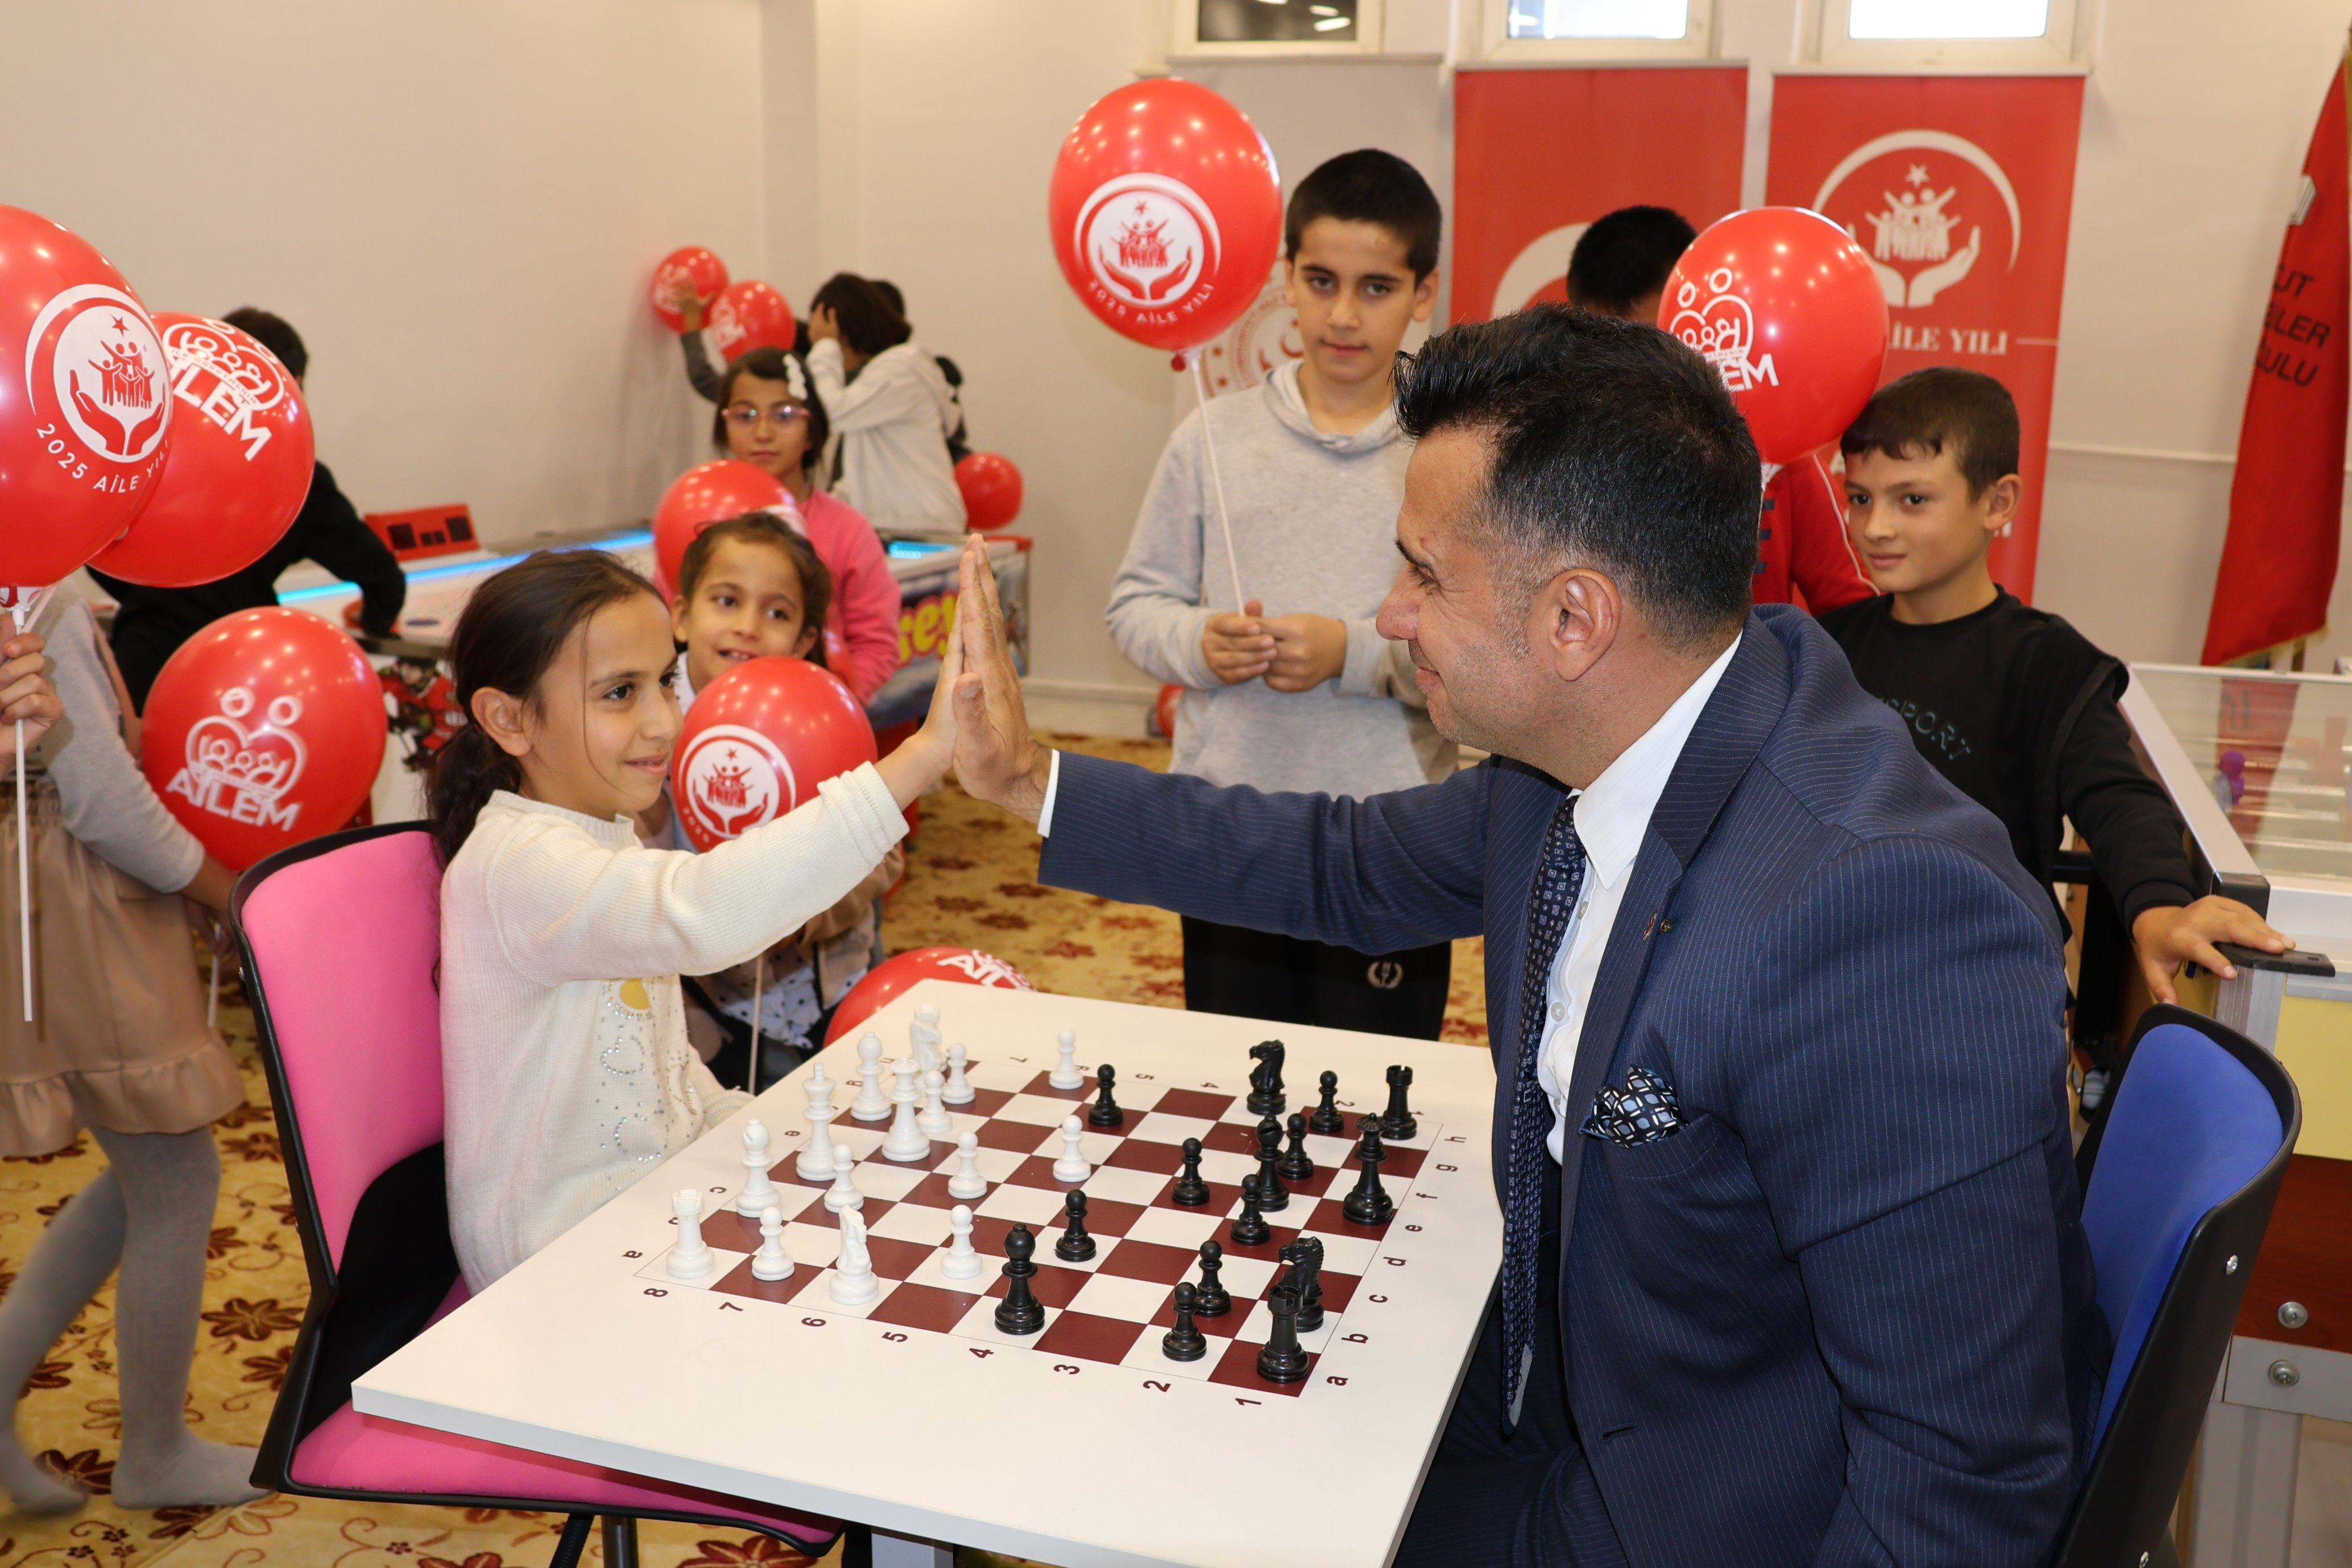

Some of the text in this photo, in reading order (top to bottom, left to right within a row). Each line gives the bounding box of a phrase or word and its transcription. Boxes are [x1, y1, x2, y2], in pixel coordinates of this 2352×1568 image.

[2273, 264, 2315, 299] UT
[1089, 278, 1214, 324] 2025 AİLE YILI
[2266, 303, 2331, 349] LER
[1888, 320, 2008, 356] İLE YILI
[1717, 353, 1780, 392] EM
[36, 423, 168, 493] 2025 AİLE YILI
[1200, 1081, 1220, 1089] 4
[1444, 1136, 1467, 1144] h
[1436, 1163, 1459, 1172] g
[1405, 1224, 1423, 1233] e
[622, 1250, 643, 1259] a
[1383, 1257, 1407, 1267] d
[1368, 1294, 1388, 1304] c
[1341, 1333, 1370, 1344] b
[643, 1288, 1263, 1406] 8 7 6 5 4 3 2 1
[1326, 1375, 1349, 1387] a
